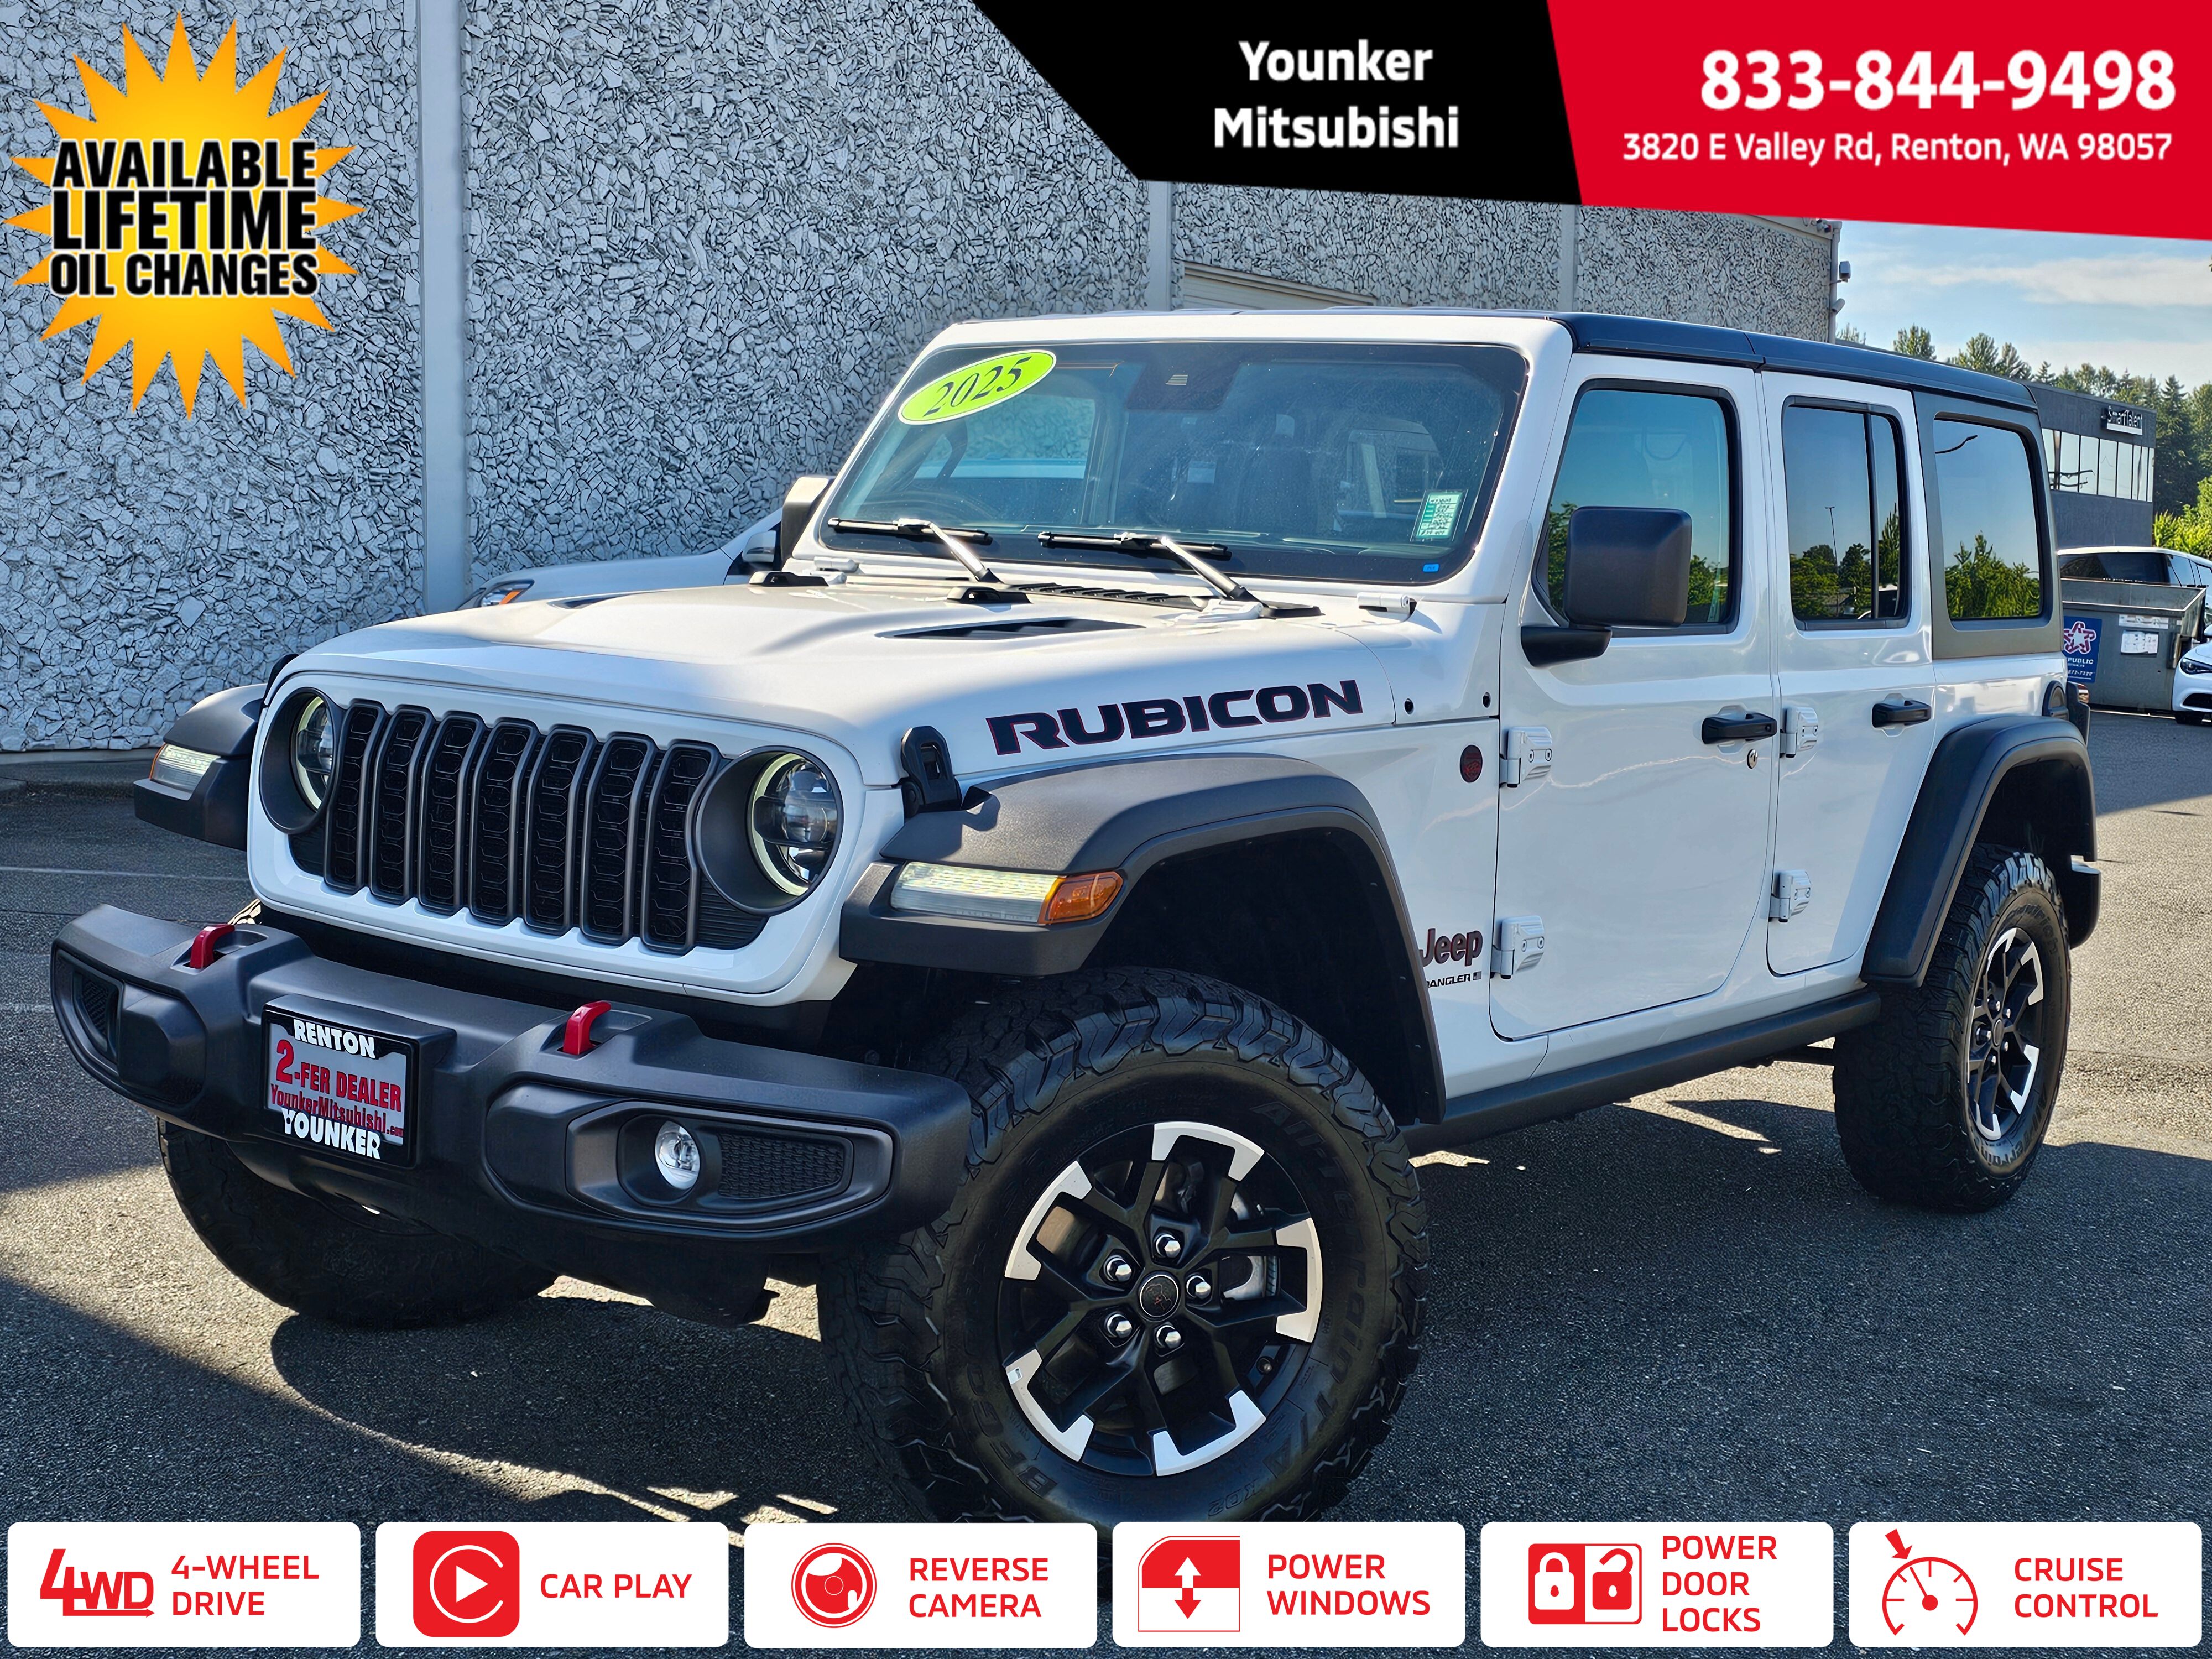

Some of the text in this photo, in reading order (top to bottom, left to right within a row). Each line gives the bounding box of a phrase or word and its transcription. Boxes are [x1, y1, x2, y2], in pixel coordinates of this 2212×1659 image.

[922, 356, 1033, 418] 2025
[985, 680, 1364, 756] RUBICON
[1419, 928, 1483, 967] Jeep
[1426, 973, 1471, 989] ANGLER
[293, 1019, 375, 1059] RENTON
[275, 1039, 401, 1113] 2-FER DEALER
[281, 1107, 381, 1160] YOUNKER
